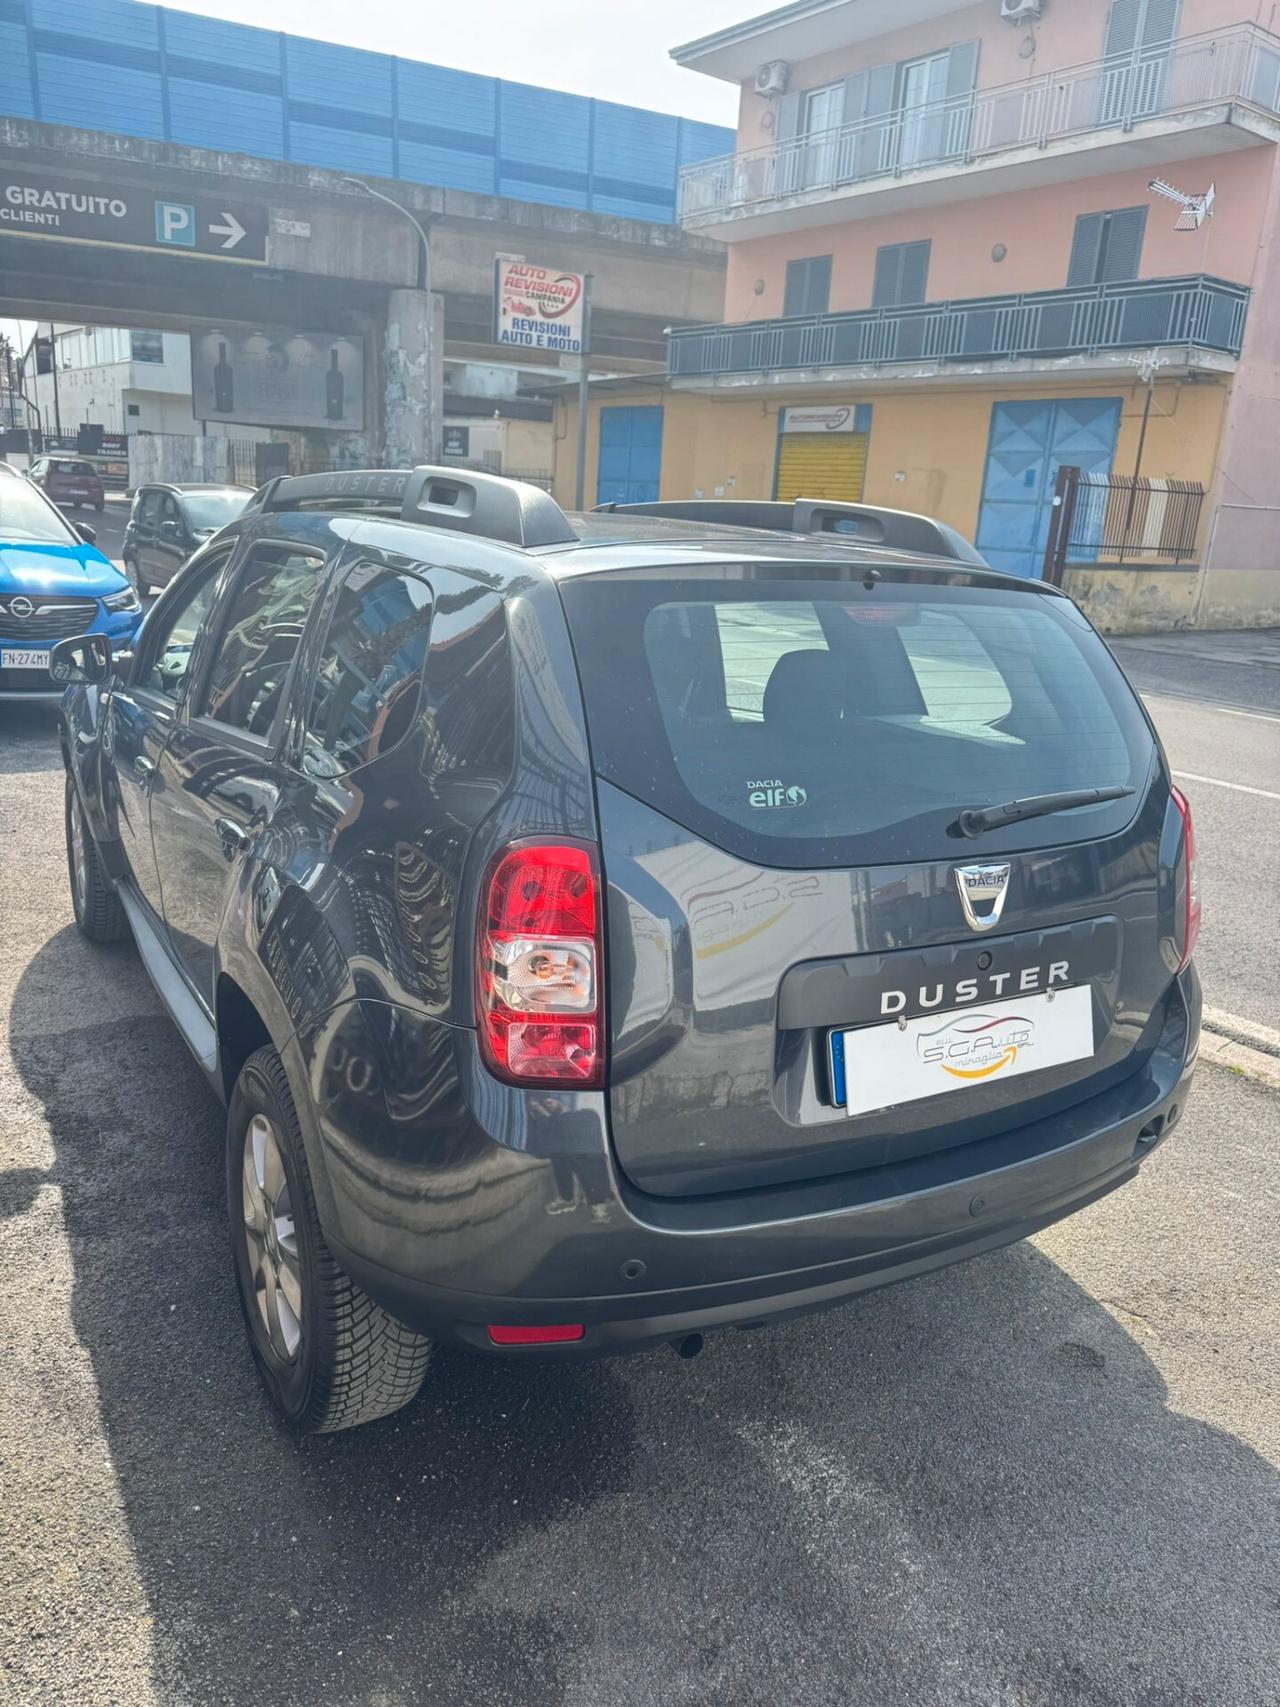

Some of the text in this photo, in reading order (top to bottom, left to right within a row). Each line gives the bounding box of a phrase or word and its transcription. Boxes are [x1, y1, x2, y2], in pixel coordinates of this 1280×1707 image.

[5, 185, 127, 218] GRATUITO
[0, 208, 60, 226] CLIENTI
[163, 205, 189, 240] P
[508, 264, 547, 280] AUTO
[504, 276, 574, 298] REVISIONI
[525, 291, 566, 304] CAMPANIA
[512, 317, 571, 337] REVISIONI
[501, 329, 580, 352] AUTO E MOTO
[746, 780, 783, 789] DACIA
[749, 788, 785, 807] elf
[968, 874, 1005, 887] DACIA
[880, 960, 1070, 1015] DUSTER
